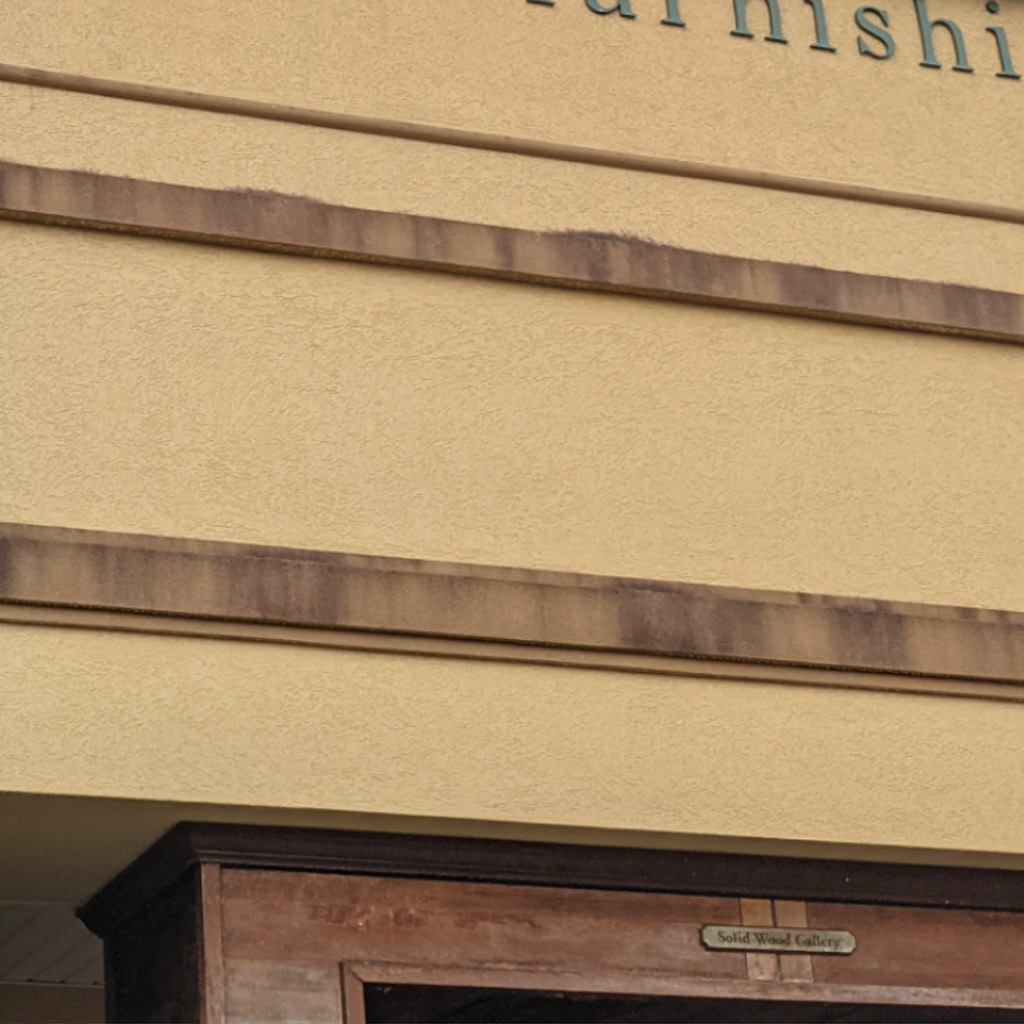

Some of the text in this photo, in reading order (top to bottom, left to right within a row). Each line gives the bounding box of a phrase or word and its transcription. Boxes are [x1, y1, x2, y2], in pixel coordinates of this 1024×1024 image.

[526, 0, 1023, 80] nishi
[717, 930, 840, 949] Solid Wood Gallery
